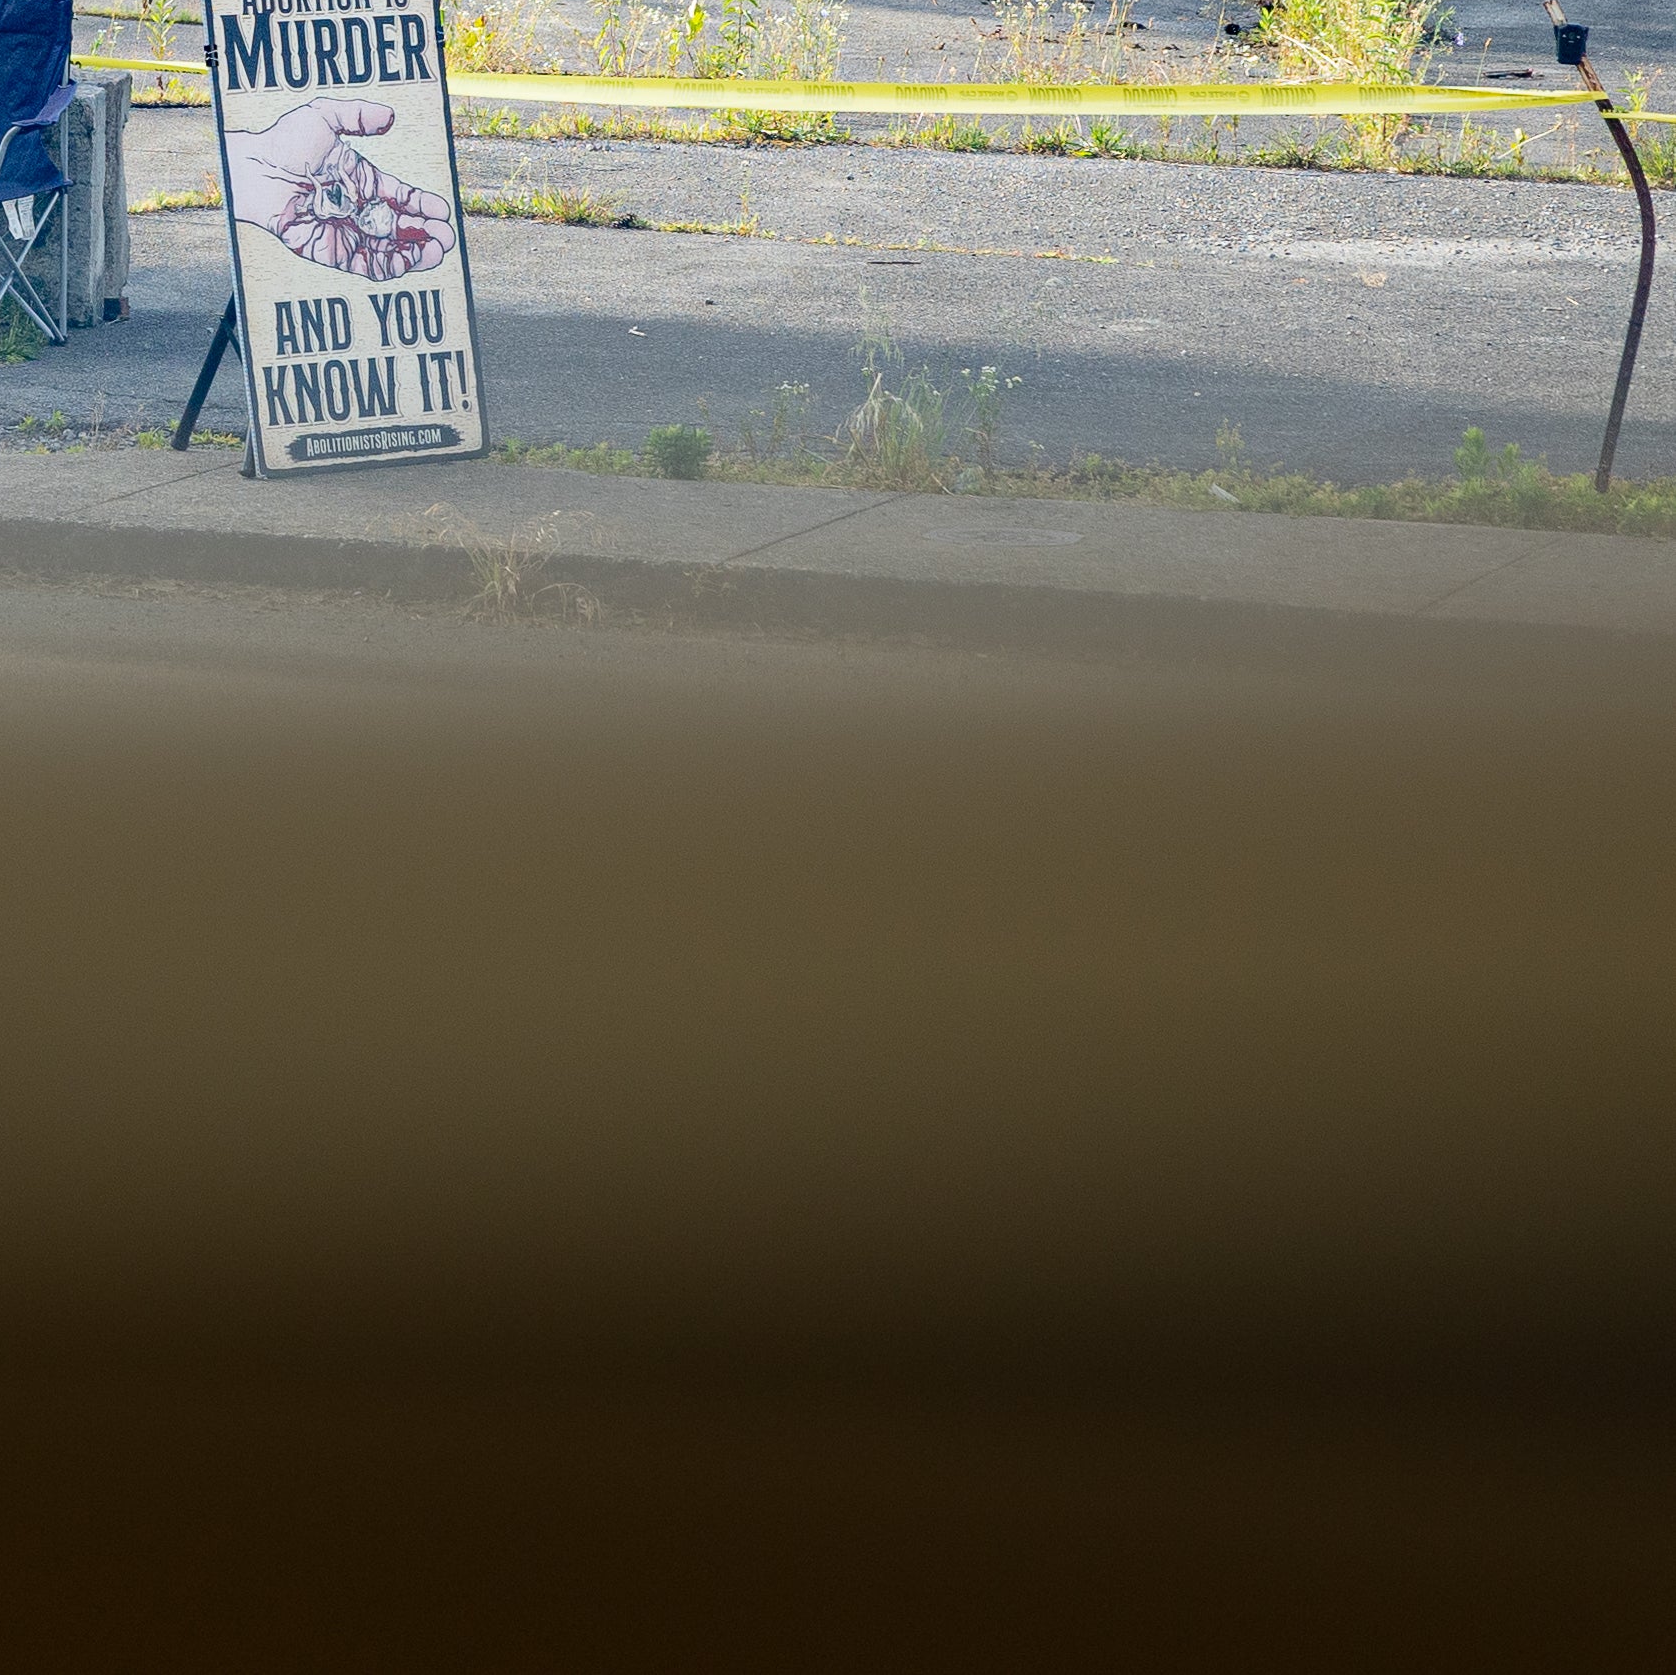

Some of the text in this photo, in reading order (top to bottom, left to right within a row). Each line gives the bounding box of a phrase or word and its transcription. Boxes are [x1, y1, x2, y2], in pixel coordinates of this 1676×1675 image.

[220, 12, 432, 91] MURDER
[274, 289, 446, 357] AND YOU
[261, 349, 470, 427] KNOW IT!
